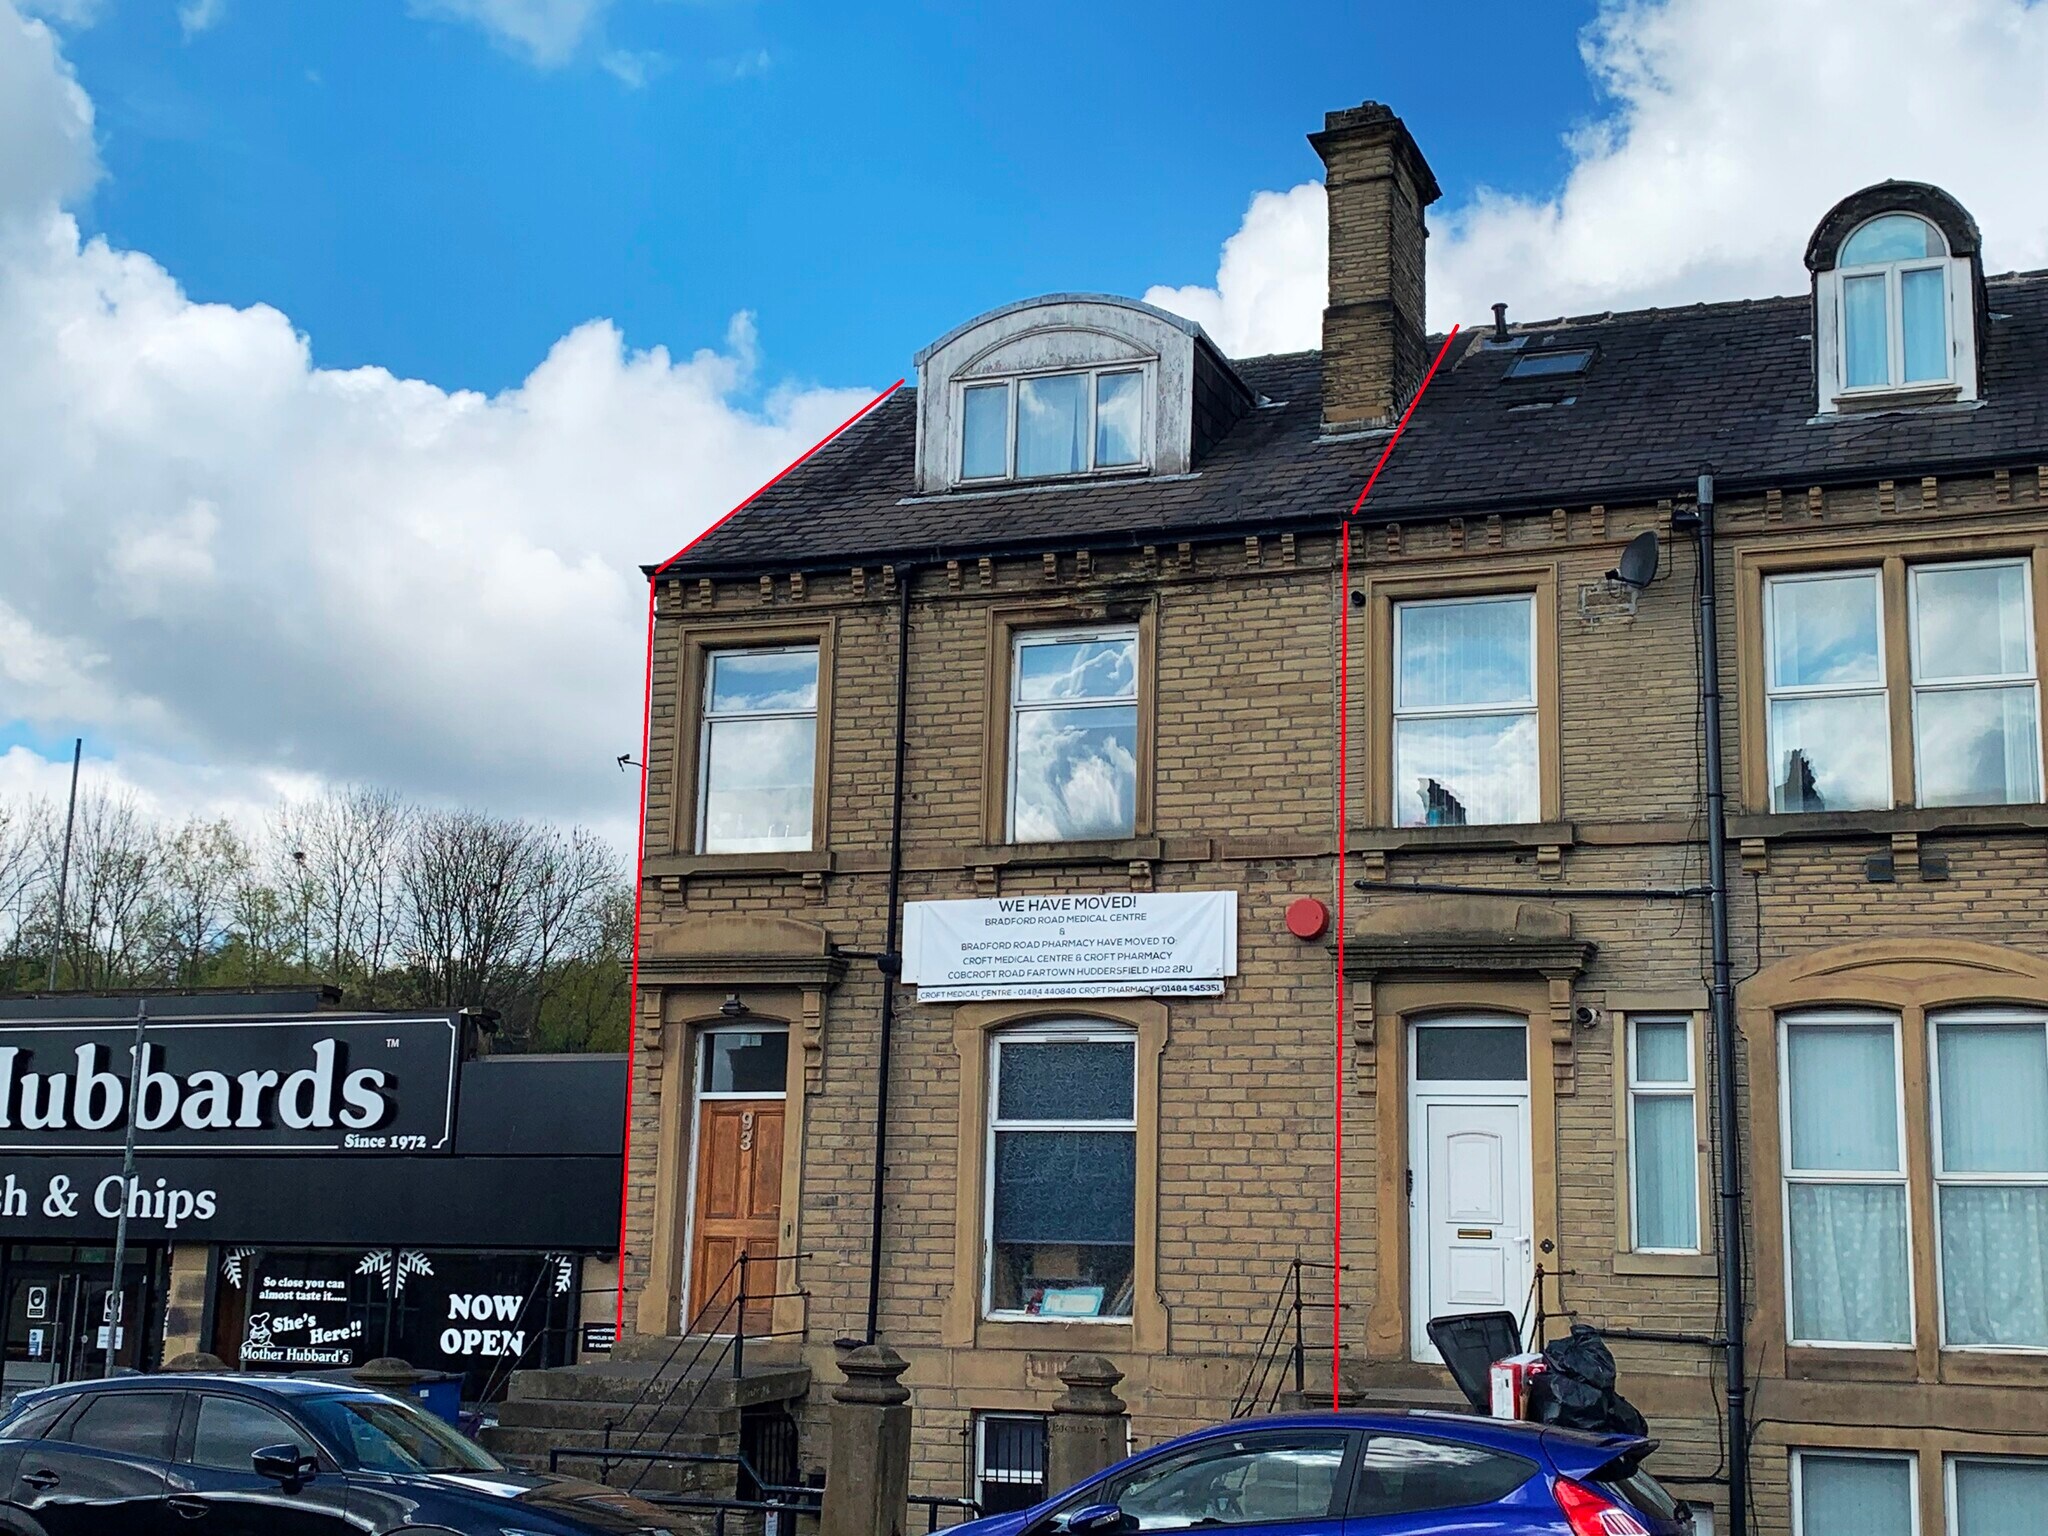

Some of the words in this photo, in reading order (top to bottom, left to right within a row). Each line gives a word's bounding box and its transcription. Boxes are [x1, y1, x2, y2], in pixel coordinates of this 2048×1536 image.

[999, 900, 1025, 912] WE
[1028, 898, 1071, 911] HAVE
[1074, 896, 1137, 910] MOVED!
[985, 917, 1036, 926] BRADFORD
[1037, 915, 1065, 924] ROAD
[1066, 914, 1108, 923] MEDICAL
[1109, 912, 1147, 922] CENTRE
[1059, 927, 1065, 936] &
[961, 941, 1012, 951] BRADFORD
[1013, 940, 1040, 949] ROAD
[1042, 938, 1095, 948] PHARMACY
[1097, 938, 1122, 947] HAVE
[1124, 937, 1160, 946] MOVED
[962, 956, 993, 965] CROFT
[994, 955, 1035, 964] MEDICAL
[1036, 954, 1073, 963] CENTRE
[1075, 953, 1082, 962] &
[1083, 952, 1116, 961] CROFT
[1117, 951, 1173, 960] PHARMACY
[948, 970, 997, 979] COBCROFT
[998, 968, 1026, 978] ROAD
[1027, 967, 1075, 977] FARTOWN
[1076, 965, 1149, 976] HUDDERSFIELD
[1150, 965, 1171, 974] HD2
[1172, 964, 1193, 973] 2RU
[920, 990, 945, 999] CROFT
[946, 989, 981, 998] MEDICAL
[981, 988, 1012, 997] CENTRE
[1078, 986, 1106, 994] CROFT
[1107, 985, 1154, 994] PHARMACY
[1161, 984, 1188, 992] 01484
[344, 1133, 386, 1149] Since
[390, 1135, 427, 1151] 1972
[42, 1174, 79, 1218] &
[94, 1174, 217, 1228] Chips
[263, 1276, 276, 1287] So
[278, 1277, 304, 1287] close
[305, 1280, 325, 1290] you
[326, 1280, 345, 1289] can
[259, 1289, 294, 1300] almost
[296, 1291, 321, 1301] taste
[447, 1293, 524, 1321] NOW
[272, 1312, 316, 1333] She's
[309, 1319, 362, 1344] Here!!
[439, 1328, 526, 1357] OPEN
[240, 1346, 284, 1360] Mother
[286, 1348, 349, 1363] Hubbard's
